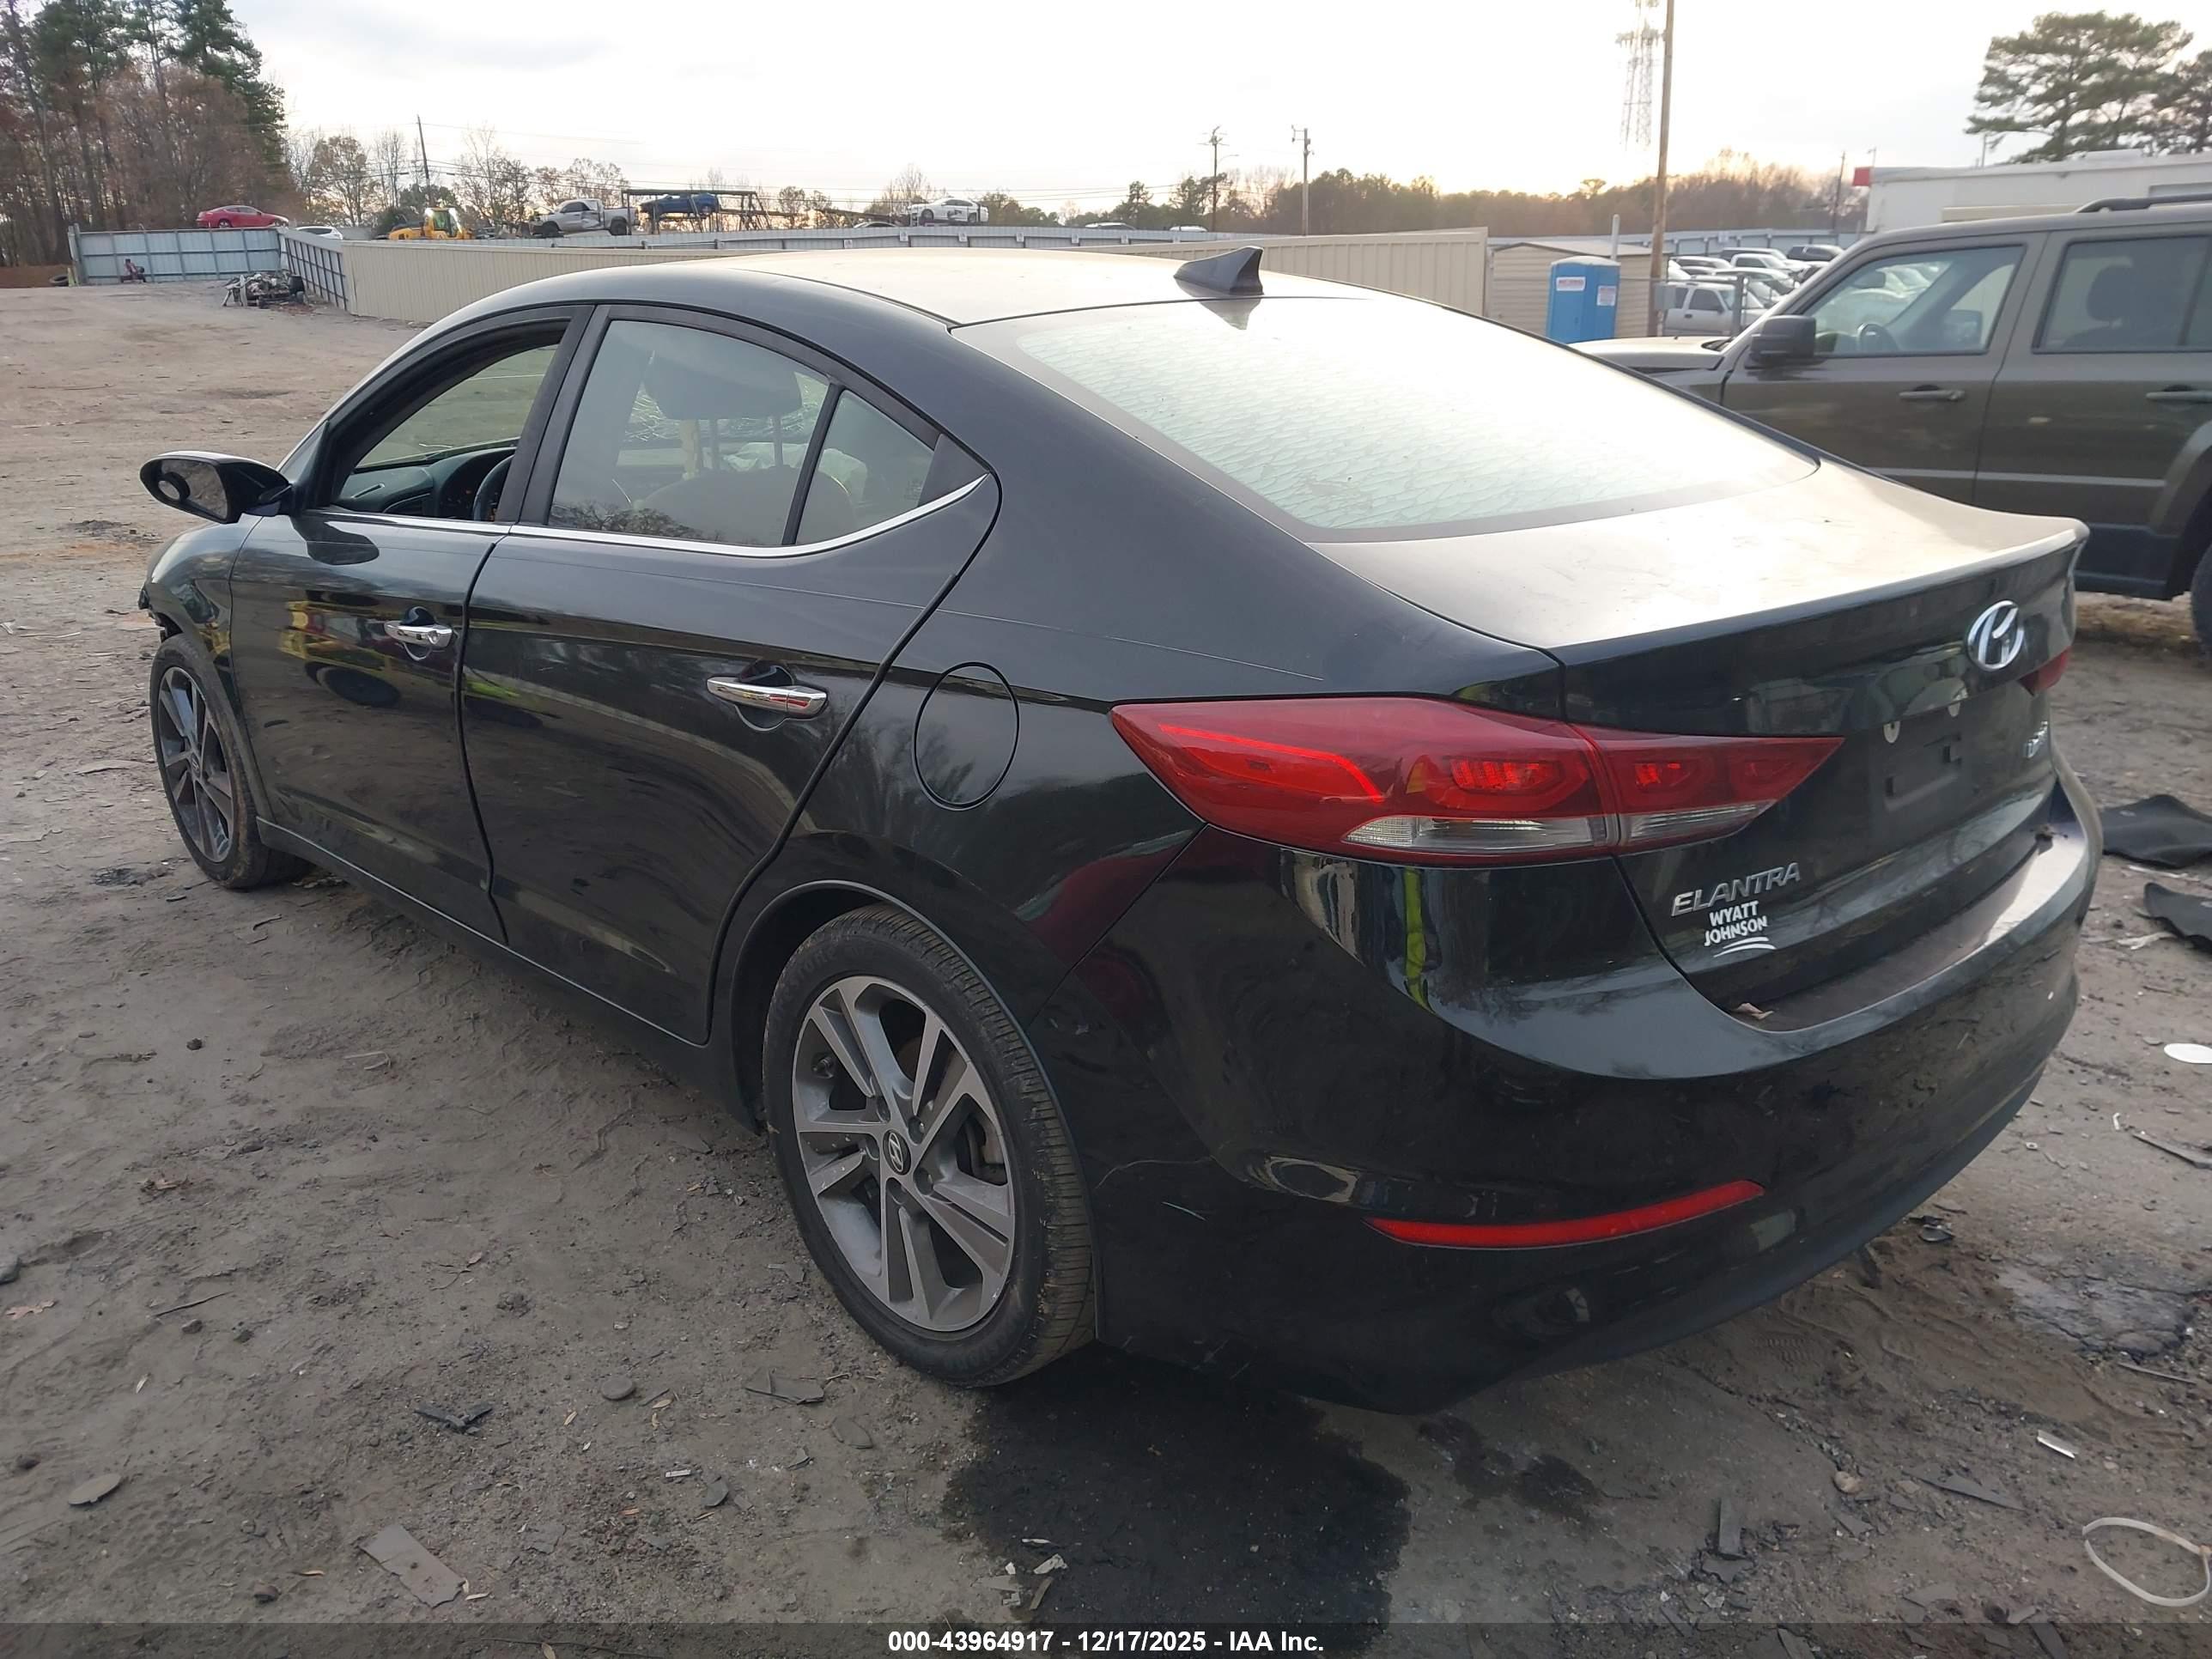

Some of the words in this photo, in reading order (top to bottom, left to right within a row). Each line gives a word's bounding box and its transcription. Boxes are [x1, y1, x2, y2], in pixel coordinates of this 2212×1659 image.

[1671, 862, 1801, 916] ELANTRA
[1709, 901, 1759, 927] WYATT
[1704, 915, 1768, 946] JOHNSON
